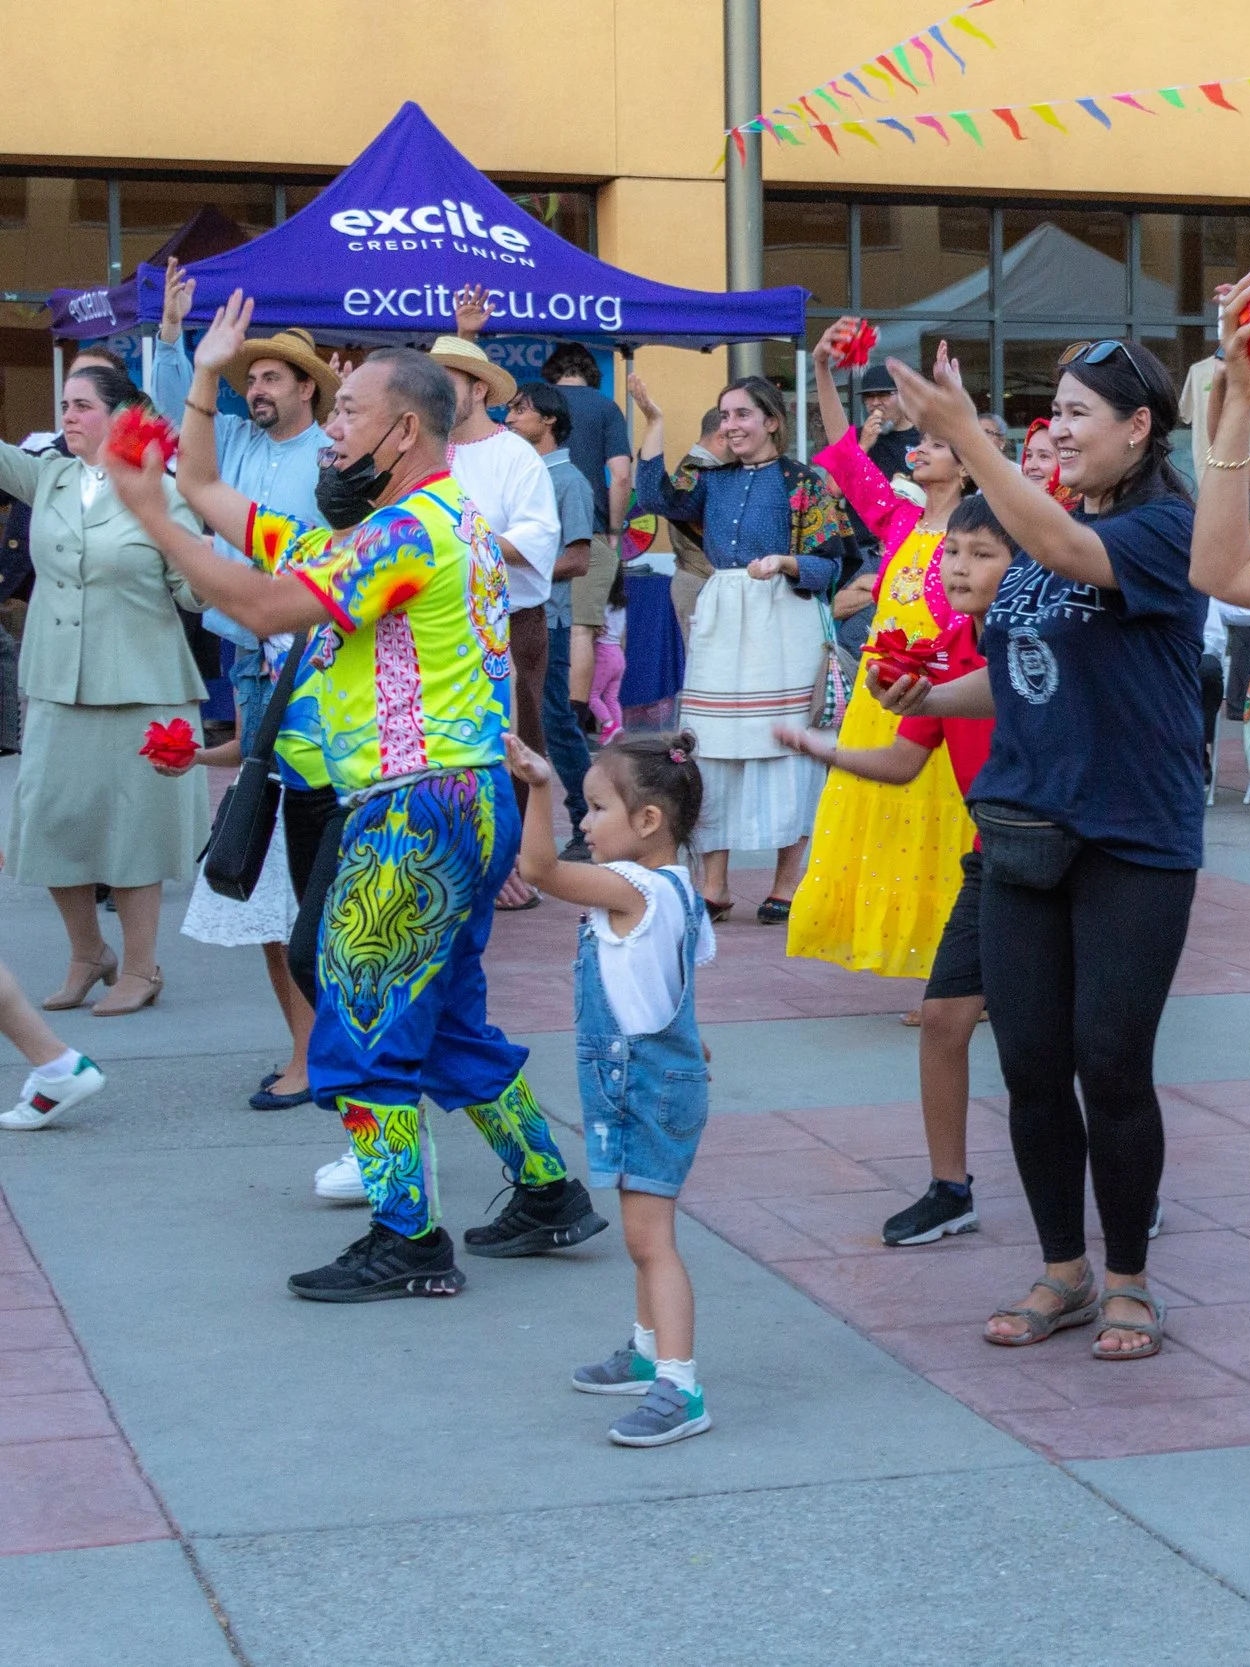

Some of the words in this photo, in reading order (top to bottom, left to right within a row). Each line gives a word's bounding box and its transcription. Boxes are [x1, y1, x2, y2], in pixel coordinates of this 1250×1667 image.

[330, 199, 531, 253] excite
[348, 239, 445, 252] CREDIT
[453, 242, 536, 268] UNION
[343, 285, 622, 332] excitcu.org
